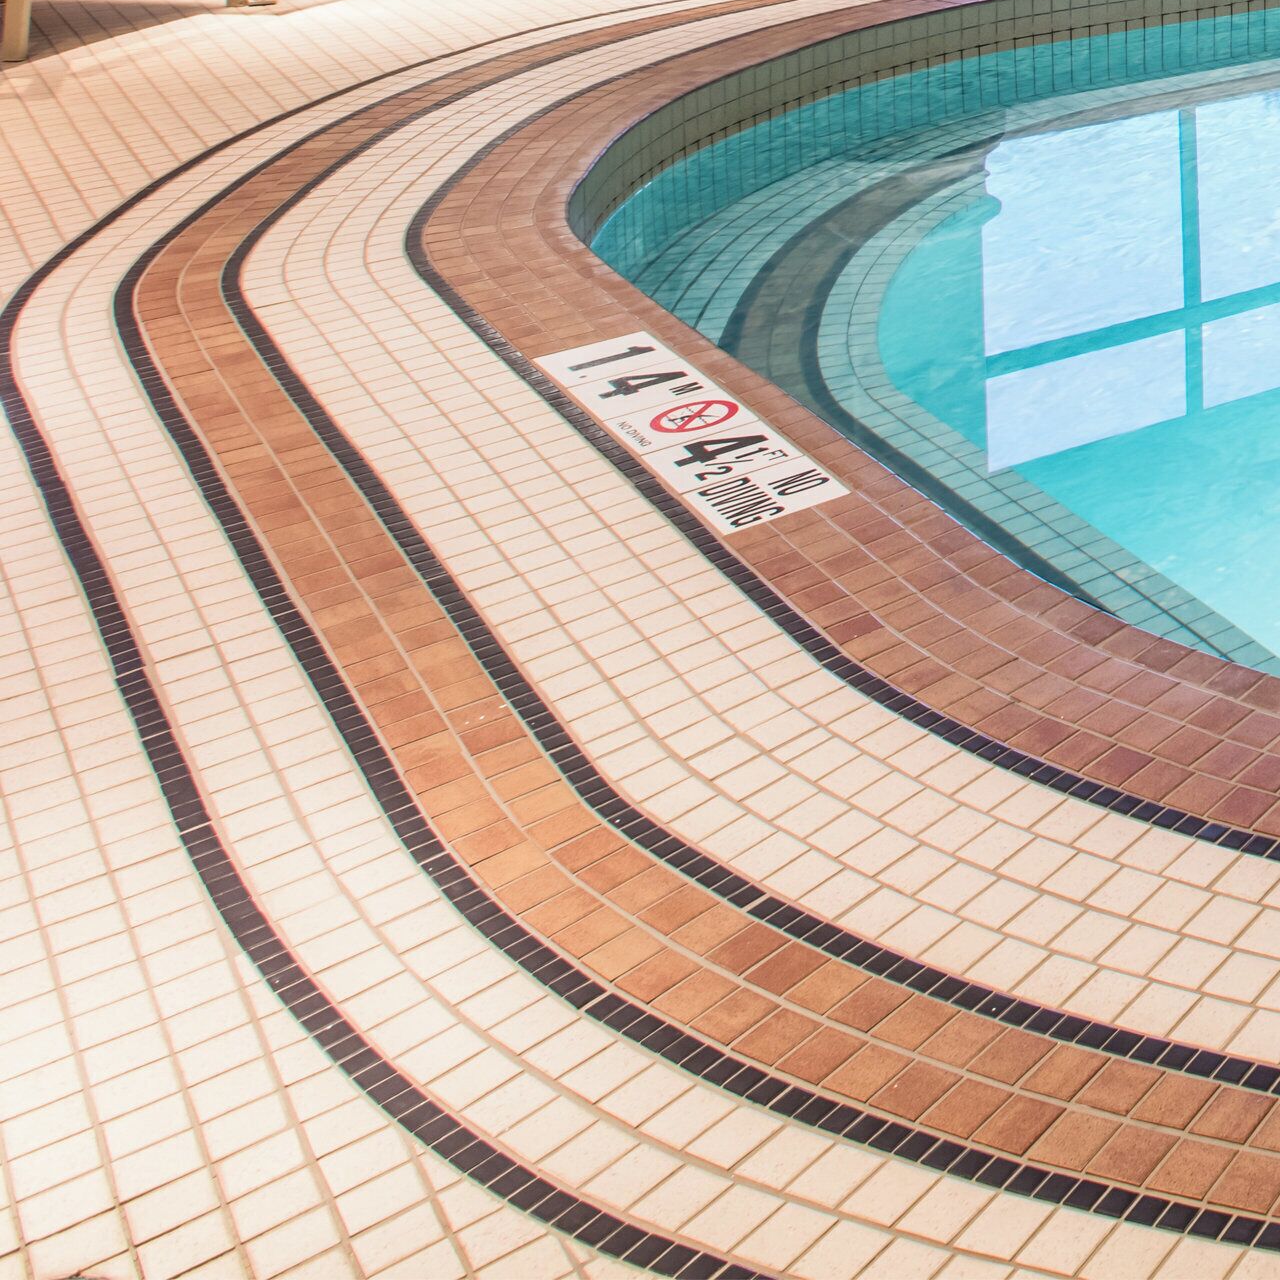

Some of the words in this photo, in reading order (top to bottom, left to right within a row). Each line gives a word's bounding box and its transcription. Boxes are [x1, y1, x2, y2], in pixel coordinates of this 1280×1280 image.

[669, 381, 704, 396] M
[763, 449, 789, 461] FT
[768, 469, 830, 496] NO
[698, 476, 785, 528] DIVING
